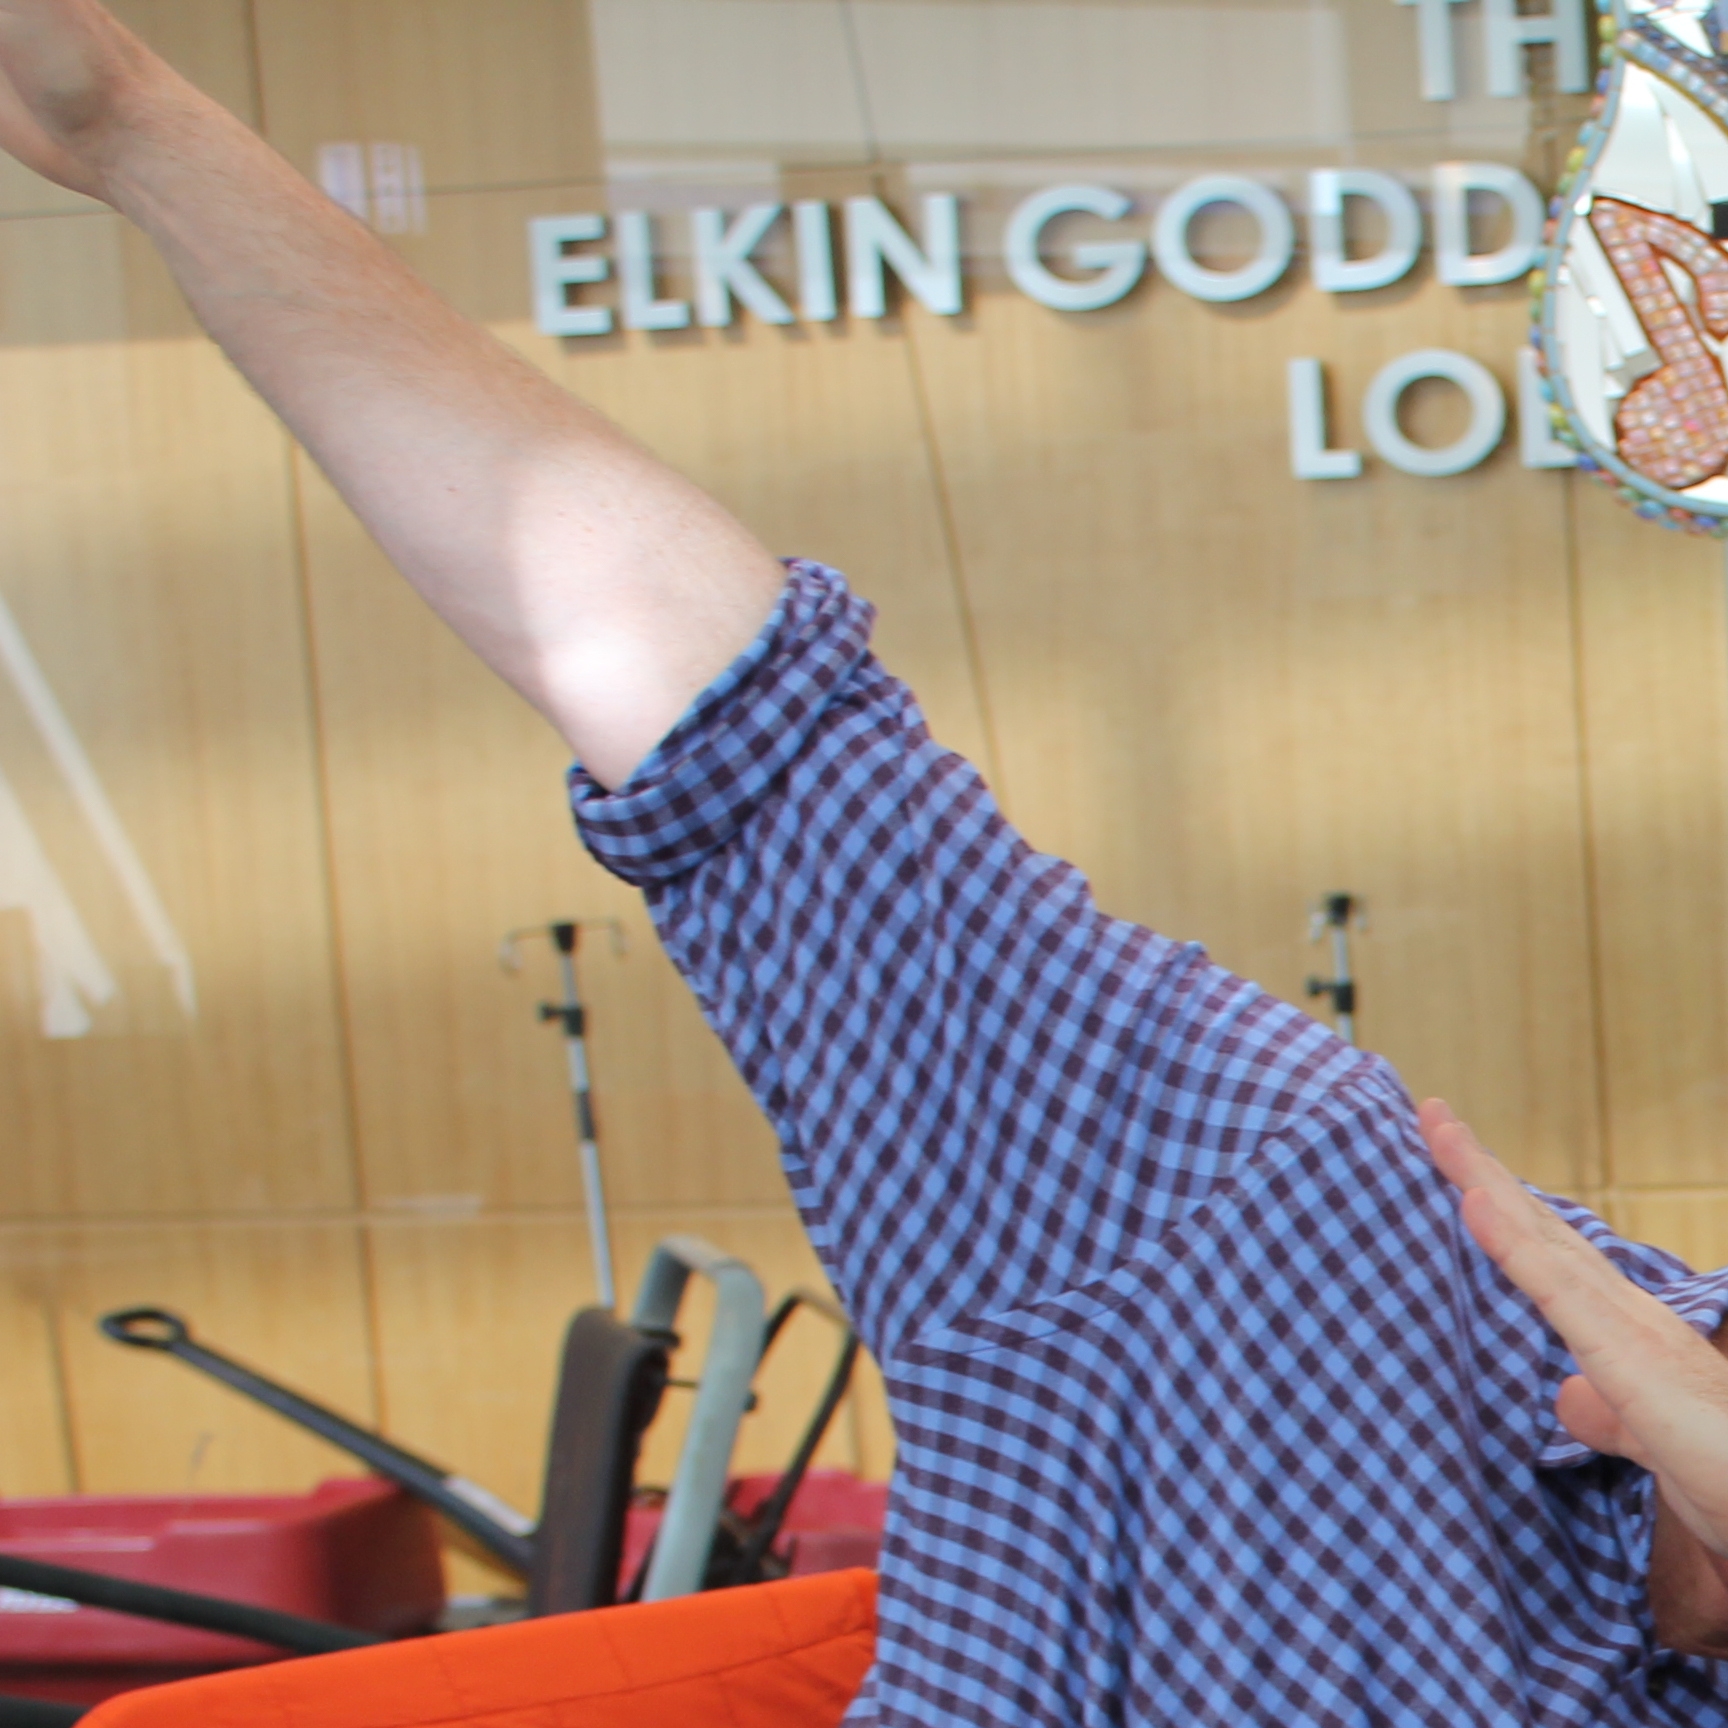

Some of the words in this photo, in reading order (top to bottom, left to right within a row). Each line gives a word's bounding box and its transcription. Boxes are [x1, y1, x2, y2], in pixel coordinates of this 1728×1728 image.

[1395, 0, 1589, 100] TH
[528, 192, 963, 337] ELKIN
[1003, 160, 1549, 311] GODD
